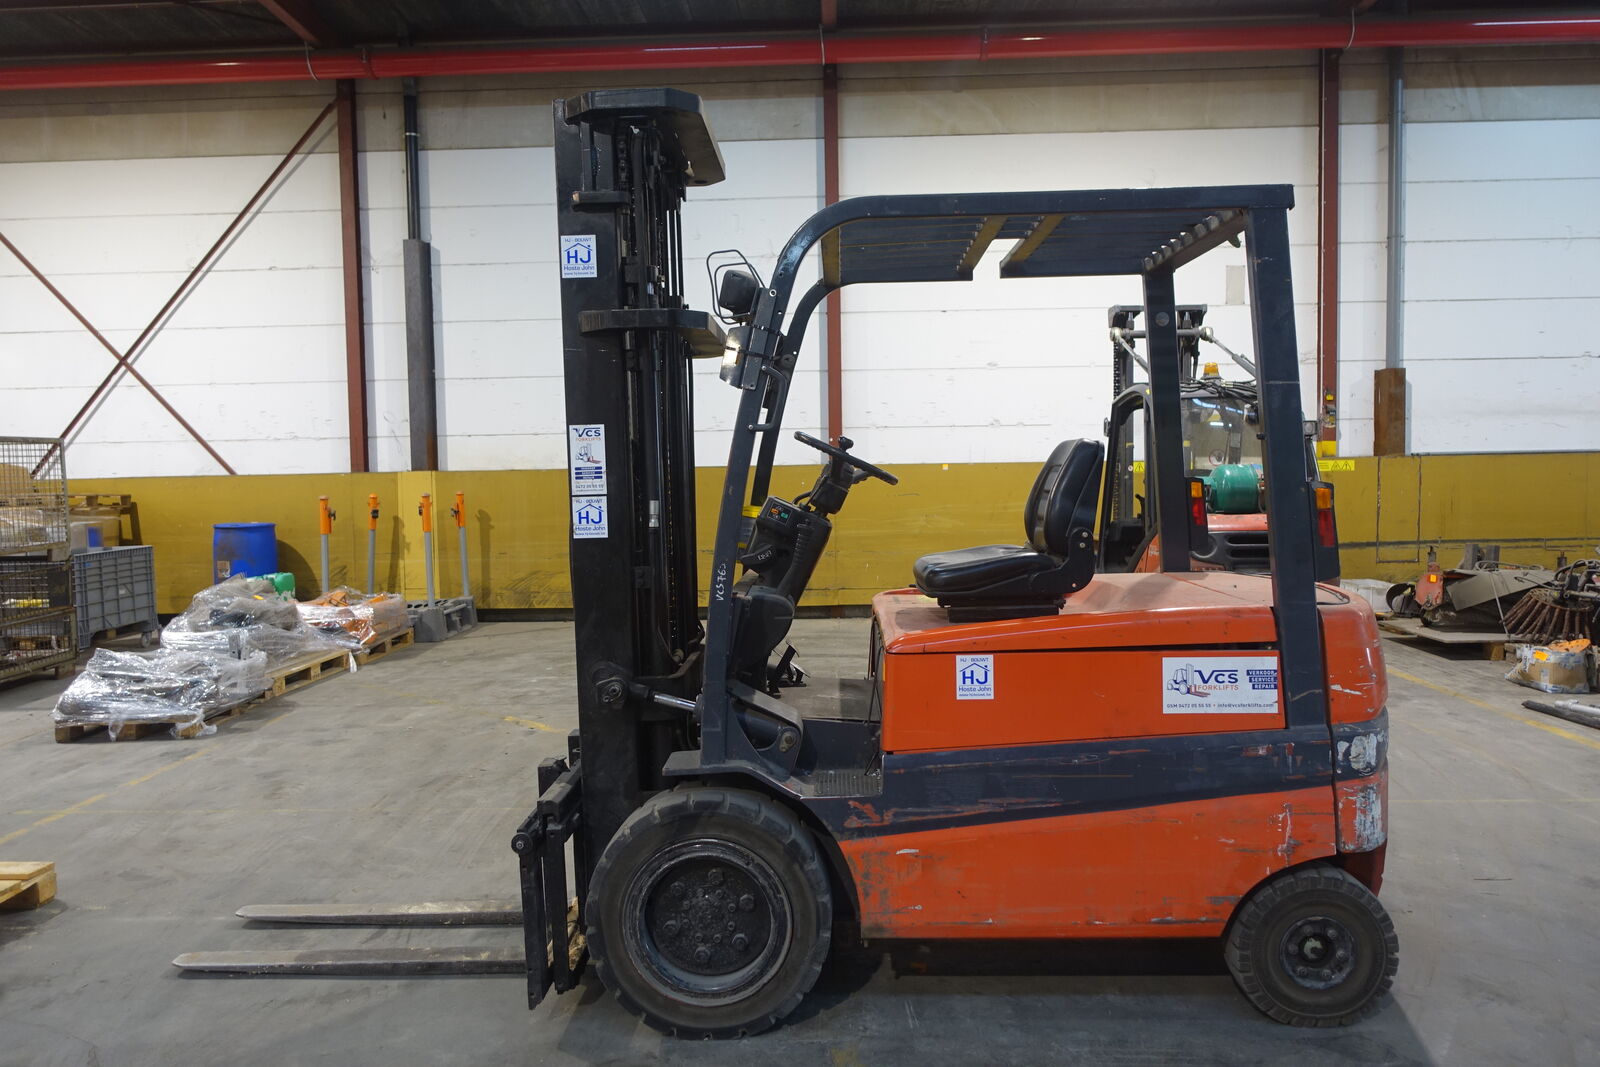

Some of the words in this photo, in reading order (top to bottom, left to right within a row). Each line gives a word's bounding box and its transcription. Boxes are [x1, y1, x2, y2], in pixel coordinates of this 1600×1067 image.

[566, 244, 591, 264] HJ
[573, 428, 601, 437] VCS
[578, 506, 602, 524] HJ
[962, 665, 988, 684] HJ
[1194, 670, 1238, 684] VCS
